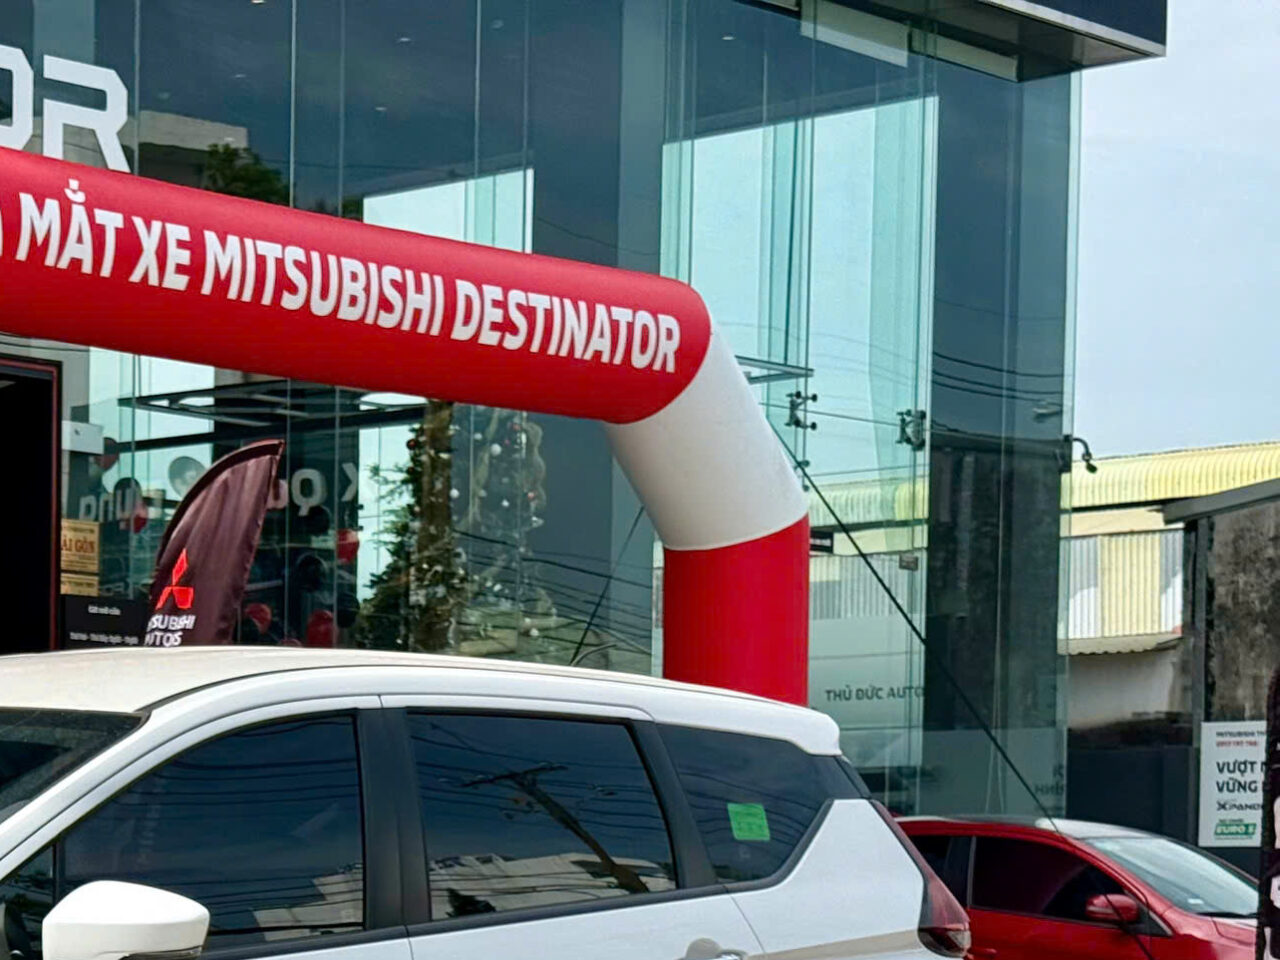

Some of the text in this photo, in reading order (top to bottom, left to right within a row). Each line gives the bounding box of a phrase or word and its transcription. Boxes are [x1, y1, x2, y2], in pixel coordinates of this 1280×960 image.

[128, 215, 192, 292] XE
[200, 229, 444, 337] MITSUBISHI
[449, 278, 682, 374] DESTINATOR
[825, 683, 924, 701] THỦ ĐỨC AUTO
[1216, 759, 1257, 777] VƯỢT
[1216, 777, 1258, 794] VỮNG
